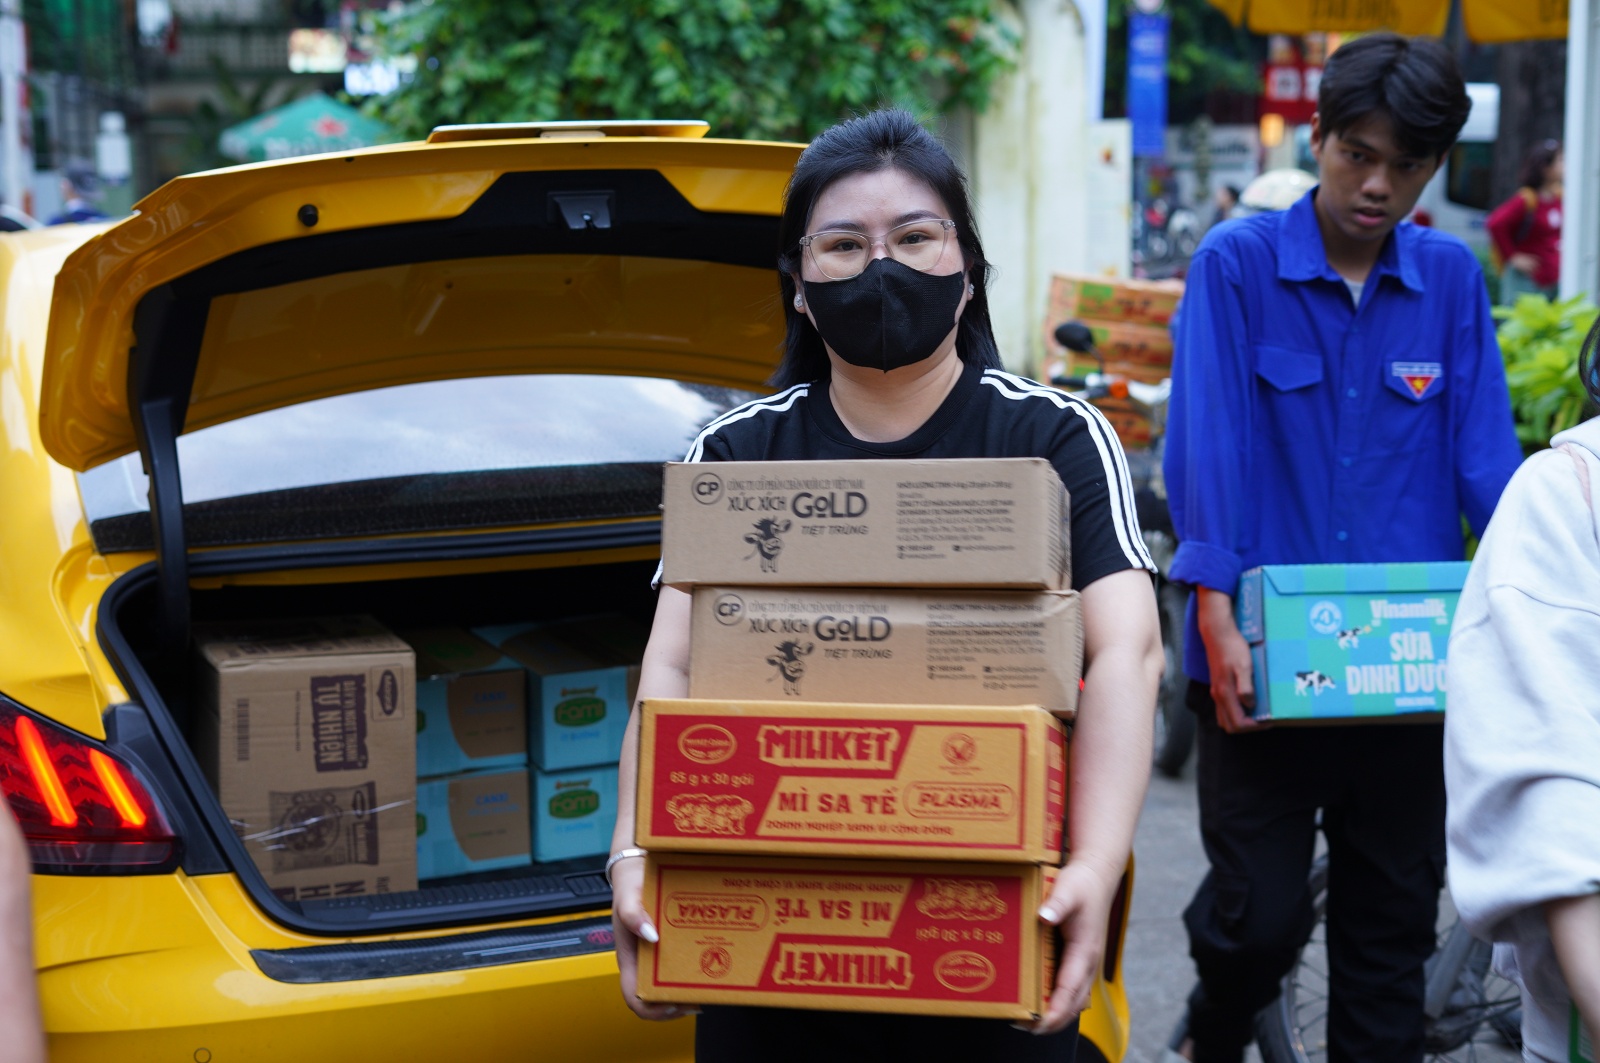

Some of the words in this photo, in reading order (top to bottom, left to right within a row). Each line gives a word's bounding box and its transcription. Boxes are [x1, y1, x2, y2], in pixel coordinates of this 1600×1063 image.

[697, 482, 719, 496] CP
[727, 492, 754, 511] XÚC
[758, 492, 787, 511] XÍCH
[718, 603, 740, 616] CP
[1369, 598, 1448, 619] Vinamilk
[749, 614, 777, 633] XÚC
[781, 614, 809, 633] XÍCH
[1390, 628, 1434, 662] SỮA
[1345, 664, 1401, 695] DINH
[761, 727, 896, 766] MILIKET
[670, 771, 687, 784] 65
[688, 774, 699, 787] g
[701, 774, 711, 784] x
[712, 772, 730, 785] 30
[730, 772, 755, 788] gói
[778, 786, 808, 812] MÌ
[818, 793, 852, 814] SA
[861, 786, 898, 815] TẾ
[919, 791, 1003, 810] PLASMA
[678, 903, 755, 920] PLASMA
[773, 897, 811, 926] TẾ
[819, 899, 852, 920] SA
[860, 901, 892, 927] MÌ
[941, 929, 960, 942] 30
[961, 929, 971, 940] x
[972, 928, 985, 941] g
[775, 948, 910, 987] MILIKET
